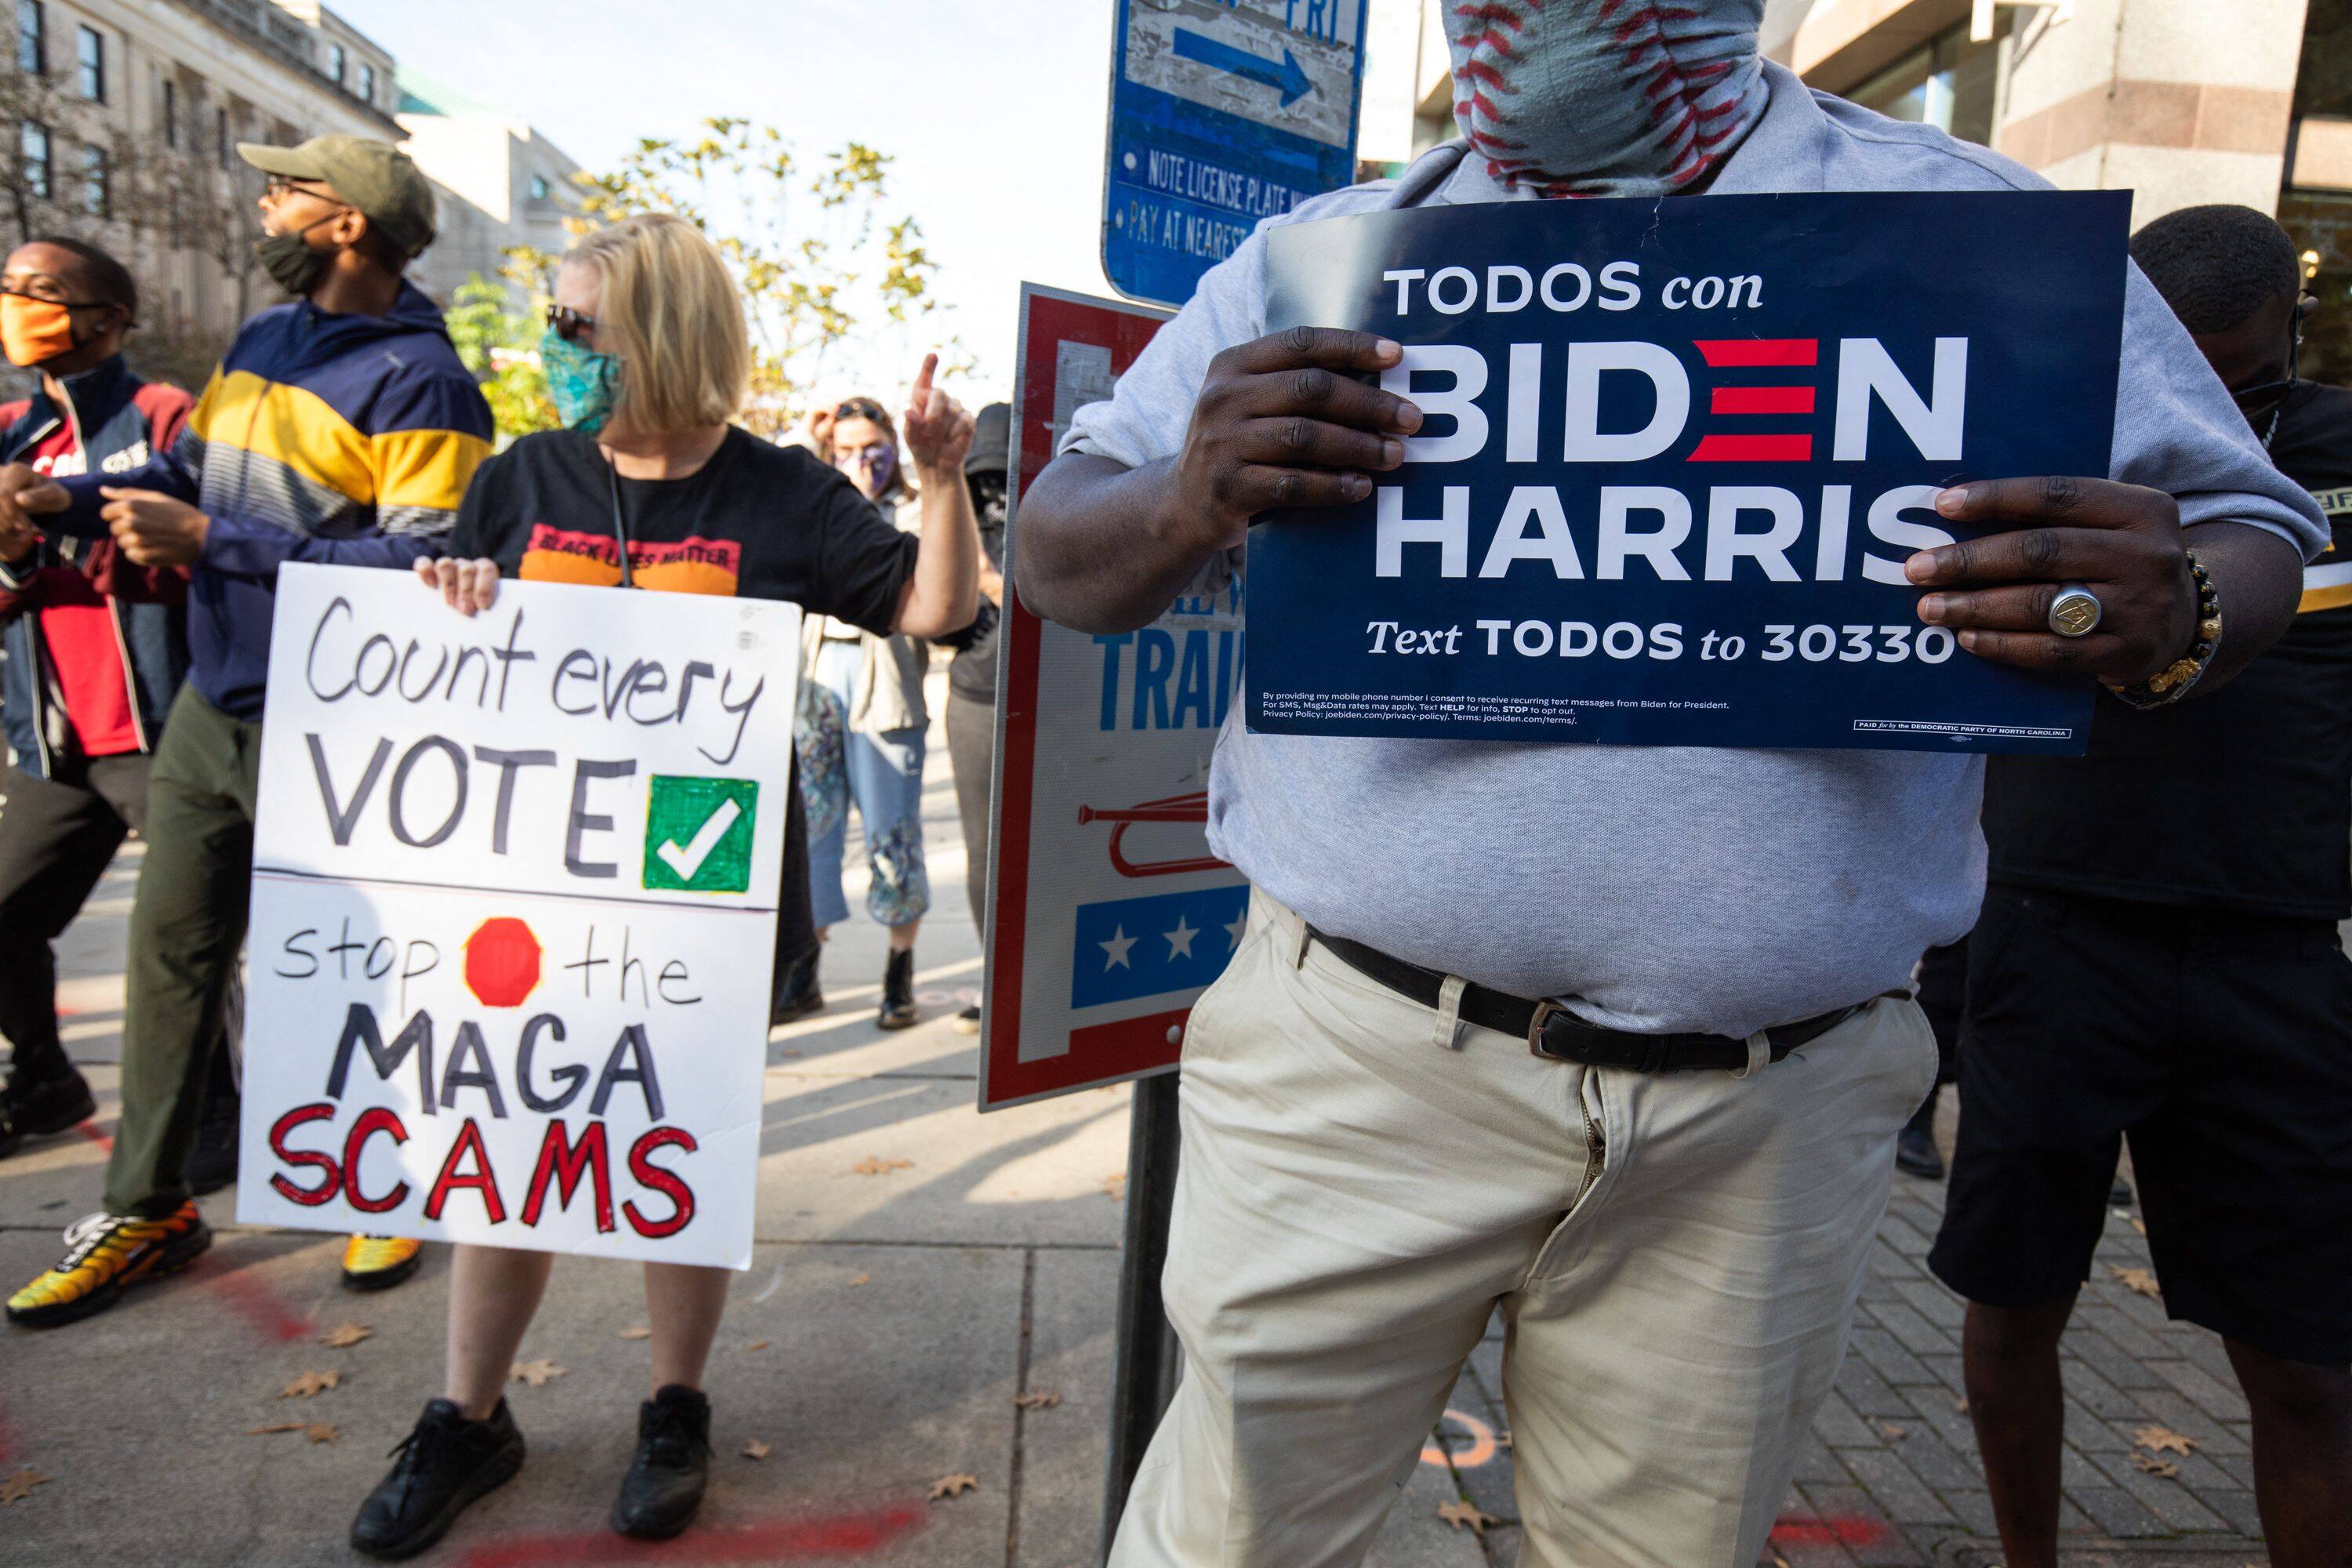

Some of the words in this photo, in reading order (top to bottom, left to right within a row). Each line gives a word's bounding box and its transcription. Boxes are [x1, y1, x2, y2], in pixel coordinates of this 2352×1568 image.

[1149, 150, 1185, 194] NOTE
[1188, 161, 1243, 210] LICENSE
[1246, 178, 1287, 216] PLATE
[1129, 201, 1159, 243] PAY
[1162, 205, 1181, 249] AT
[1383, 261, 1640, 315] TODOS
[1662, 274, 1763, 310] con
[1380, 336, 1969, 463] BIDEN
[539, 534, 600, 561] BLACK
[604, 546, 655, 570] LVES
[662, 546, 728, 566] MATTER
[1375, 485, 1957, 586] HARRIS
[307, 597, 535, 712] Count
[552, 648, 765, 765] every
[1093, 629, 1245, 731] TRAI
[1366, 620, 1462, 655] Text
[1475, 619, 1683, 660] TODOS
[1700, 630, 1745, 661] to
[1761, 624, 1955, 664] 30330
[1262, 691, 1274, 701] By
[1276, 692, 1314, 702] providing
[1362, 693, 1388, 703] phone
[1390, 694, 1423, 702] number
[1430, 695, 1465, 703] consent
[1477, 695, 1508, 704] receive
[1511, 696, 1549, 706] recurring
[1551, 697, 1569, 706] text
[1570, 699, 1614, 708] messages
[1617, 699, 1638, 707] from
[1640, 699, 1666, 708] Biden
[1684, 700, 1729, 710] President.
[1263, 710, 1293, 719] Privacy
[1295, 710, 1323, 720] Policy:
[1324, 710, 1450, 720] joebiden.com/privacy-policy/.
[1483, 713, 1577, 724] joebiden.com/terms/.
[1279, 701, 1301, 710] SMS,
[1303, 701, 1346, 711] Msg&Data
[1391, 702, 1416, 712] apply.
[1439, 703, 1465, 712] HELP
[1481, 704, 1500, 714] info,
[1502, 705, 1528, 713] STOP
[1541, 706, 1556, 716] opt
[1558, 706, 1575, 715] out.
[304, 732, 637, 878] VOTE
[274, 916, 441, 1018] stop
[563, 925, 702, 1009] the
[325, 1002, 665, 1122] MAGA
[268, 1102, 698, 1239] SCAMS
